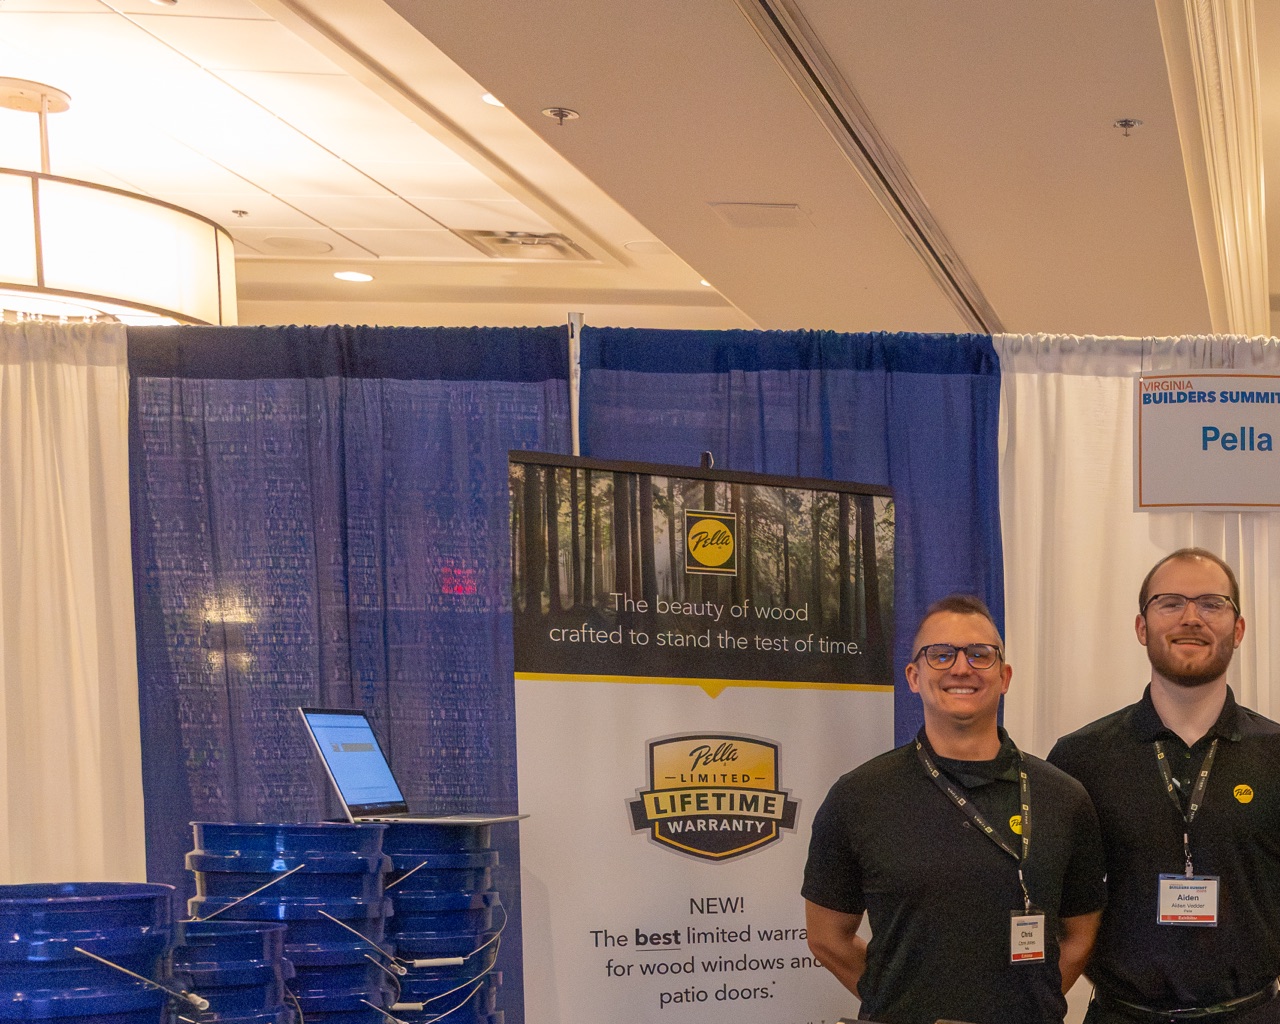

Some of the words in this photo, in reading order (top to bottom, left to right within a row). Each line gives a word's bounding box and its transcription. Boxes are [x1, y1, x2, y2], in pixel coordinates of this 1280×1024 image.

[1142, 380, 1193, 391] VIRGINIA
[1142, 391, 1217, 405] BUILDERS
[1202, 426, 1273, 451] Pella
[691, 529, 732, 549] Pella
[609, 592, 649, 613] The
[655, 594, 724, 622] beauty
[730, 599, 750, 619] of
[754, 603, 809, 622] wood
[549, 623, 622, 645] crafted
[629, 628, 649, 646] to
[656, 627, 710, 649] stand
[717, 630, 748, 650] the
[754, 634, 789, 652] test
[794, 634, 814, 653] of
[818, 637, 863, 655] time.
[689, 742, 739, 771] Pella
[680, 773, 751, 784] LIMITED
[653, 792, 777, 815] LIFETIME
[667, 818, 766, 835] WARRANTY
[689, 897, 745, 915] NEW!
[590, 930, 628, 948] The
[634, 928, 681, 947] best
[686, 925, 751, 945] limited
[757, 928, 808, 942] warra
[605, 958, 634, 978] for
[640, 956, 695, 976] wood
[701, 953, 785, 974] windows
[659, 986, 708, 1010] patio
